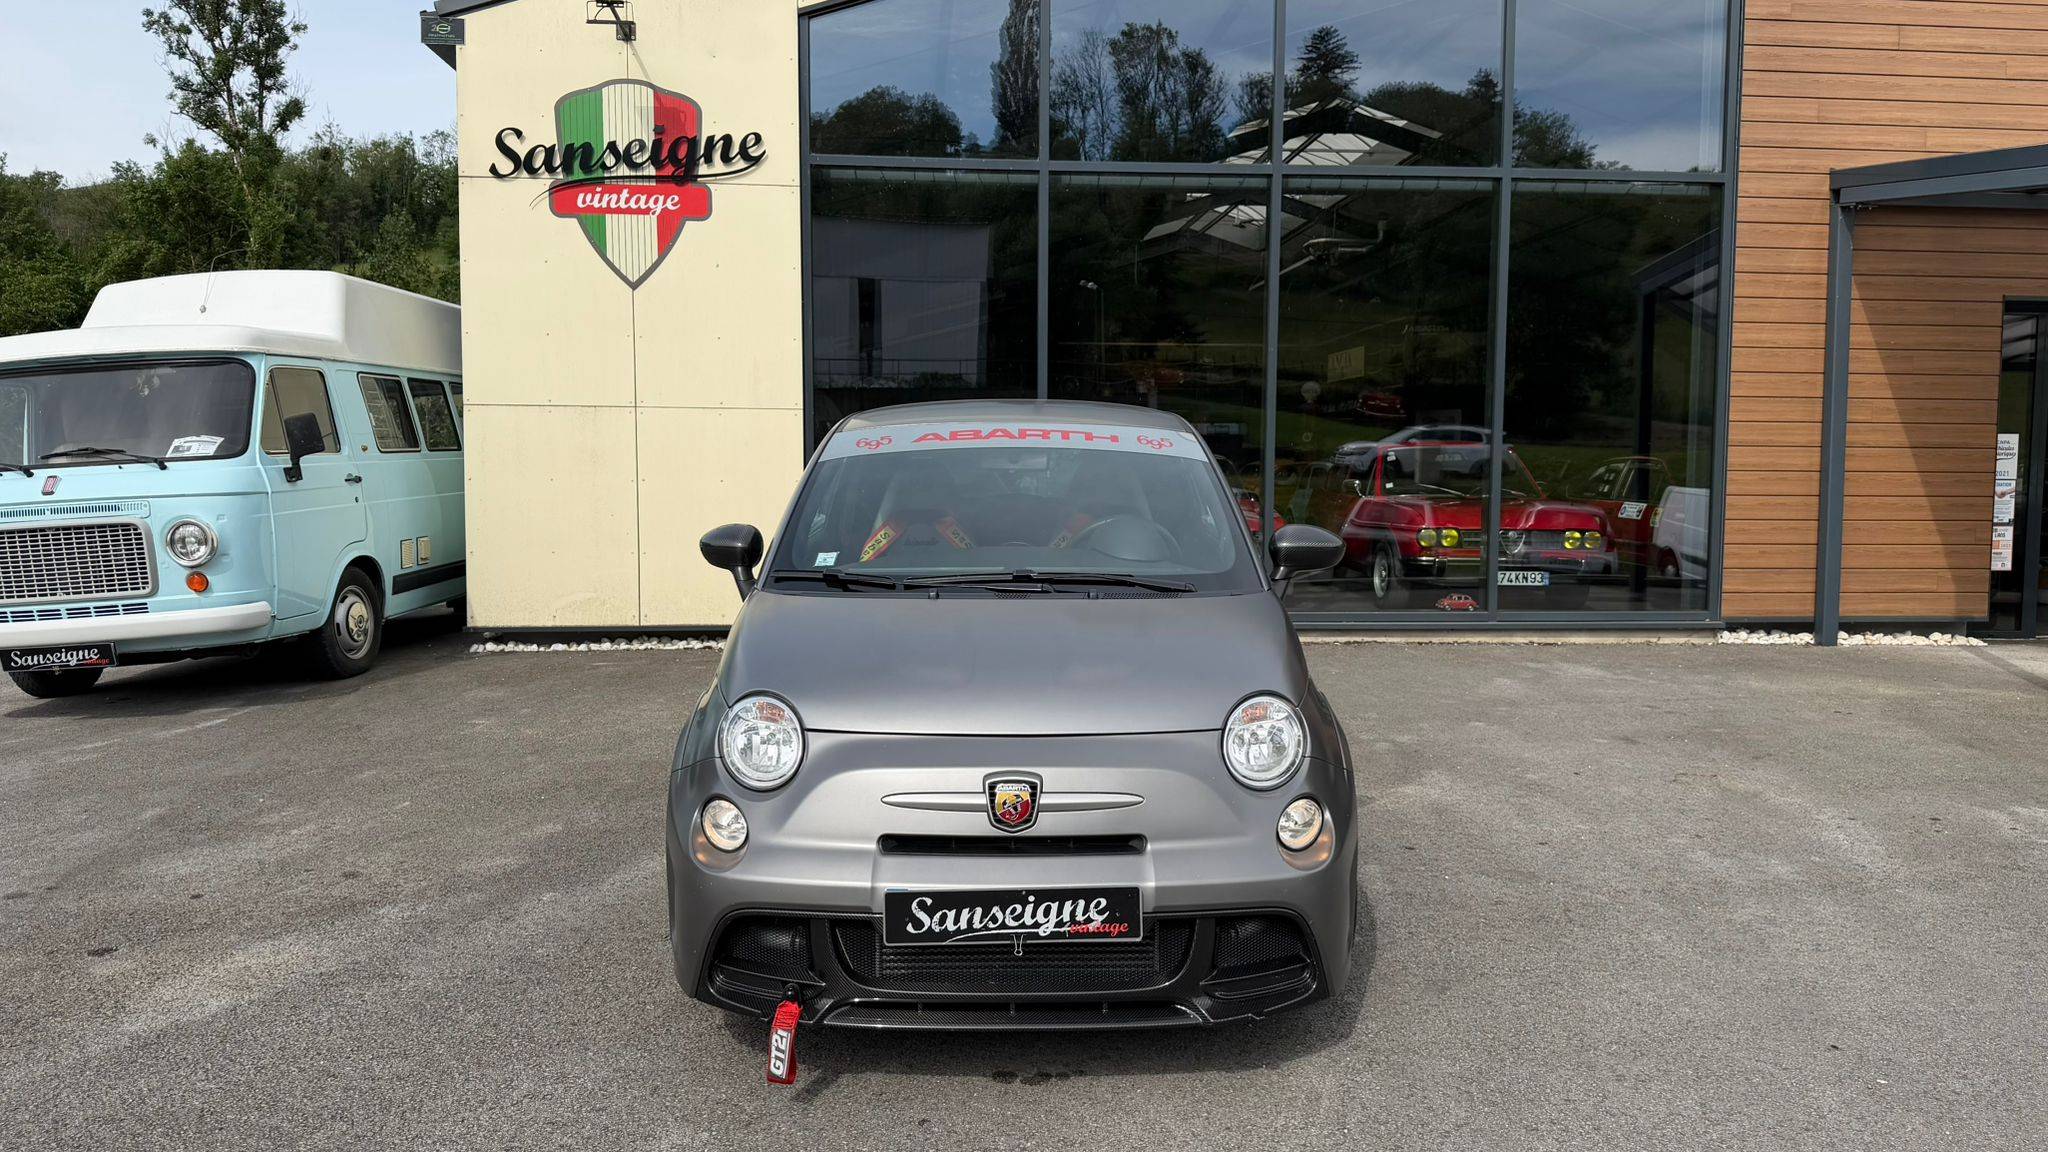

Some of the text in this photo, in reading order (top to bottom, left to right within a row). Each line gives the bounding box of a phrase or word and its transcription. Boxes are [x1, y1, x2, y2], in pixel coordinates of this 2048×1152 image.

[489, 124, 768, 184] Sanseigne
[576, 186, 681, 217] vintage
[855, 428, 1174, 450] 695 ABARTH 695
[1500, 572, 1544, 584] 74KN93
[10, 648, 100, 667] Sanseigne
[906, 895, 1110, 937] Sanseigne
[1068, 921, 1129, 937] vintage
